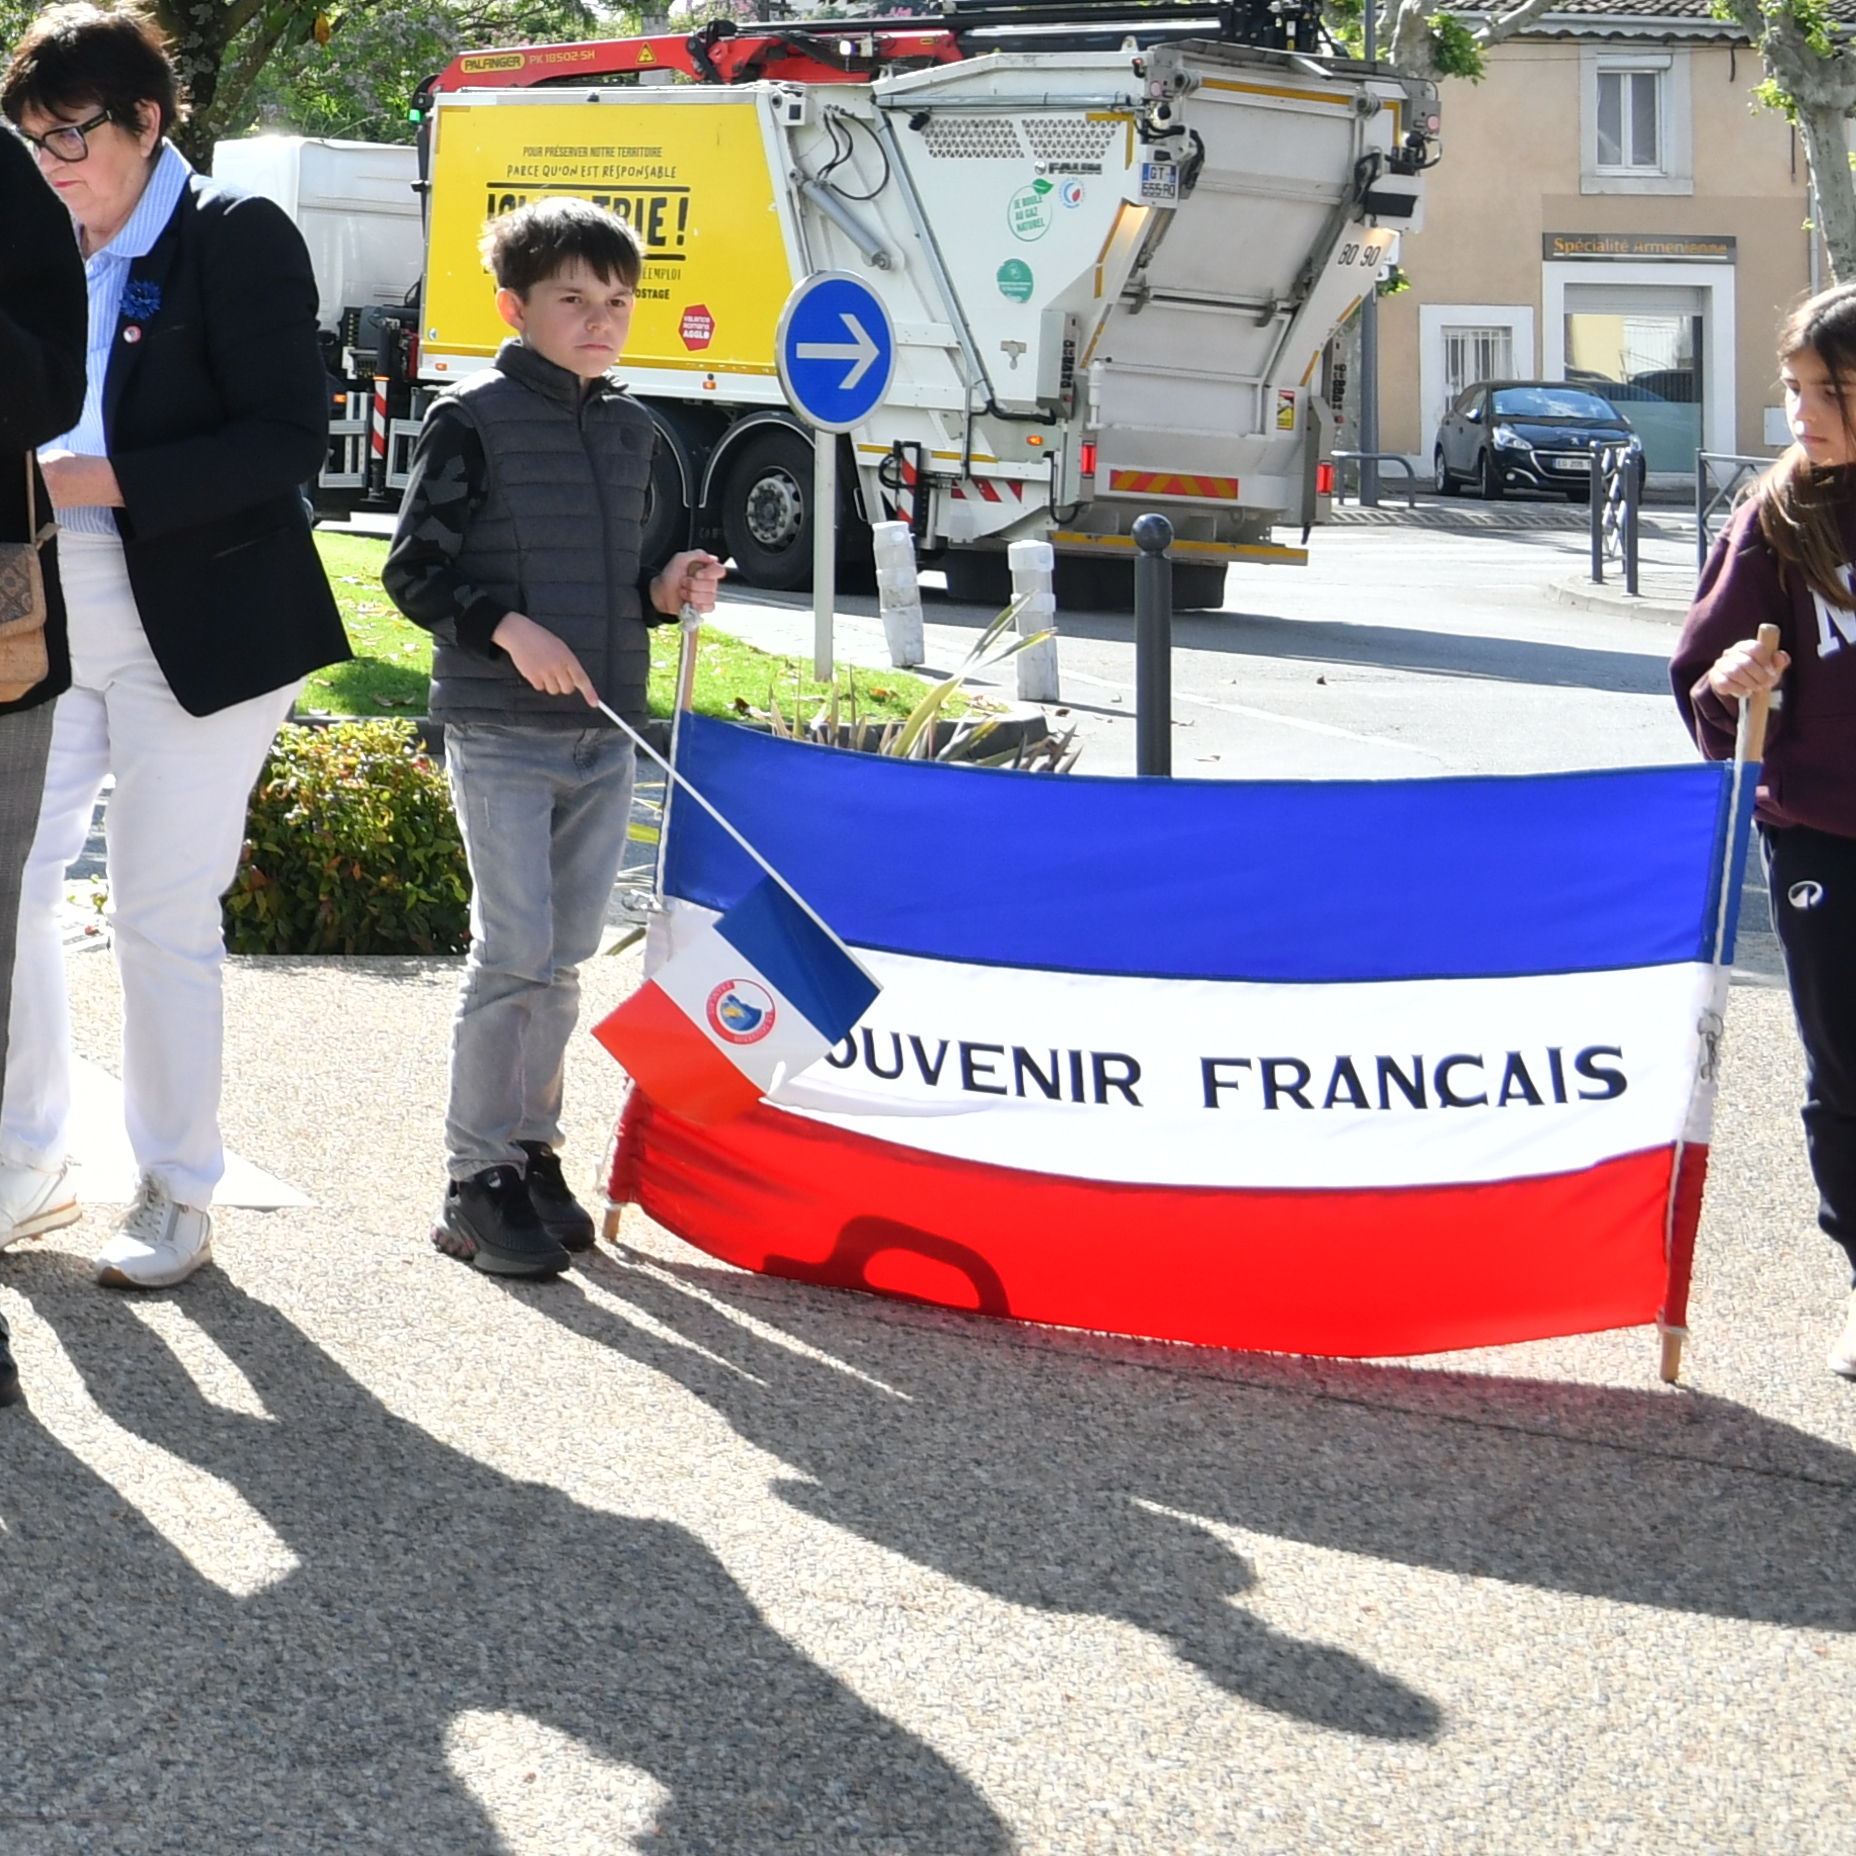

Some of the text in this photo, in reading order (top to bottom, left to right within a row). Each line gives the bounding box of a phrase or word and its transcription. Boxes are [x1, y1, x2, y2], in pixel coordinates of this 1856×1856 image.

[465, 55, 521, 71] PALFINGER
[529, 54, 543, 65] PK
[523, 146, 543, 158] POUR
[590, 146, 615, 158] NOTRE
[617, 146, 662, 158] TERRITOIRE
[507, 164, 539, 178] PARCE
[581, 165, 599, 178] EST
[602, 164, 676, 179] RESPONSABLE
[641, 265, 682, 280] ÉEMPLOI
[634, 288, 670, 300] OSTAGE
[825, 1025, 1144, 1107] OUVENIR
